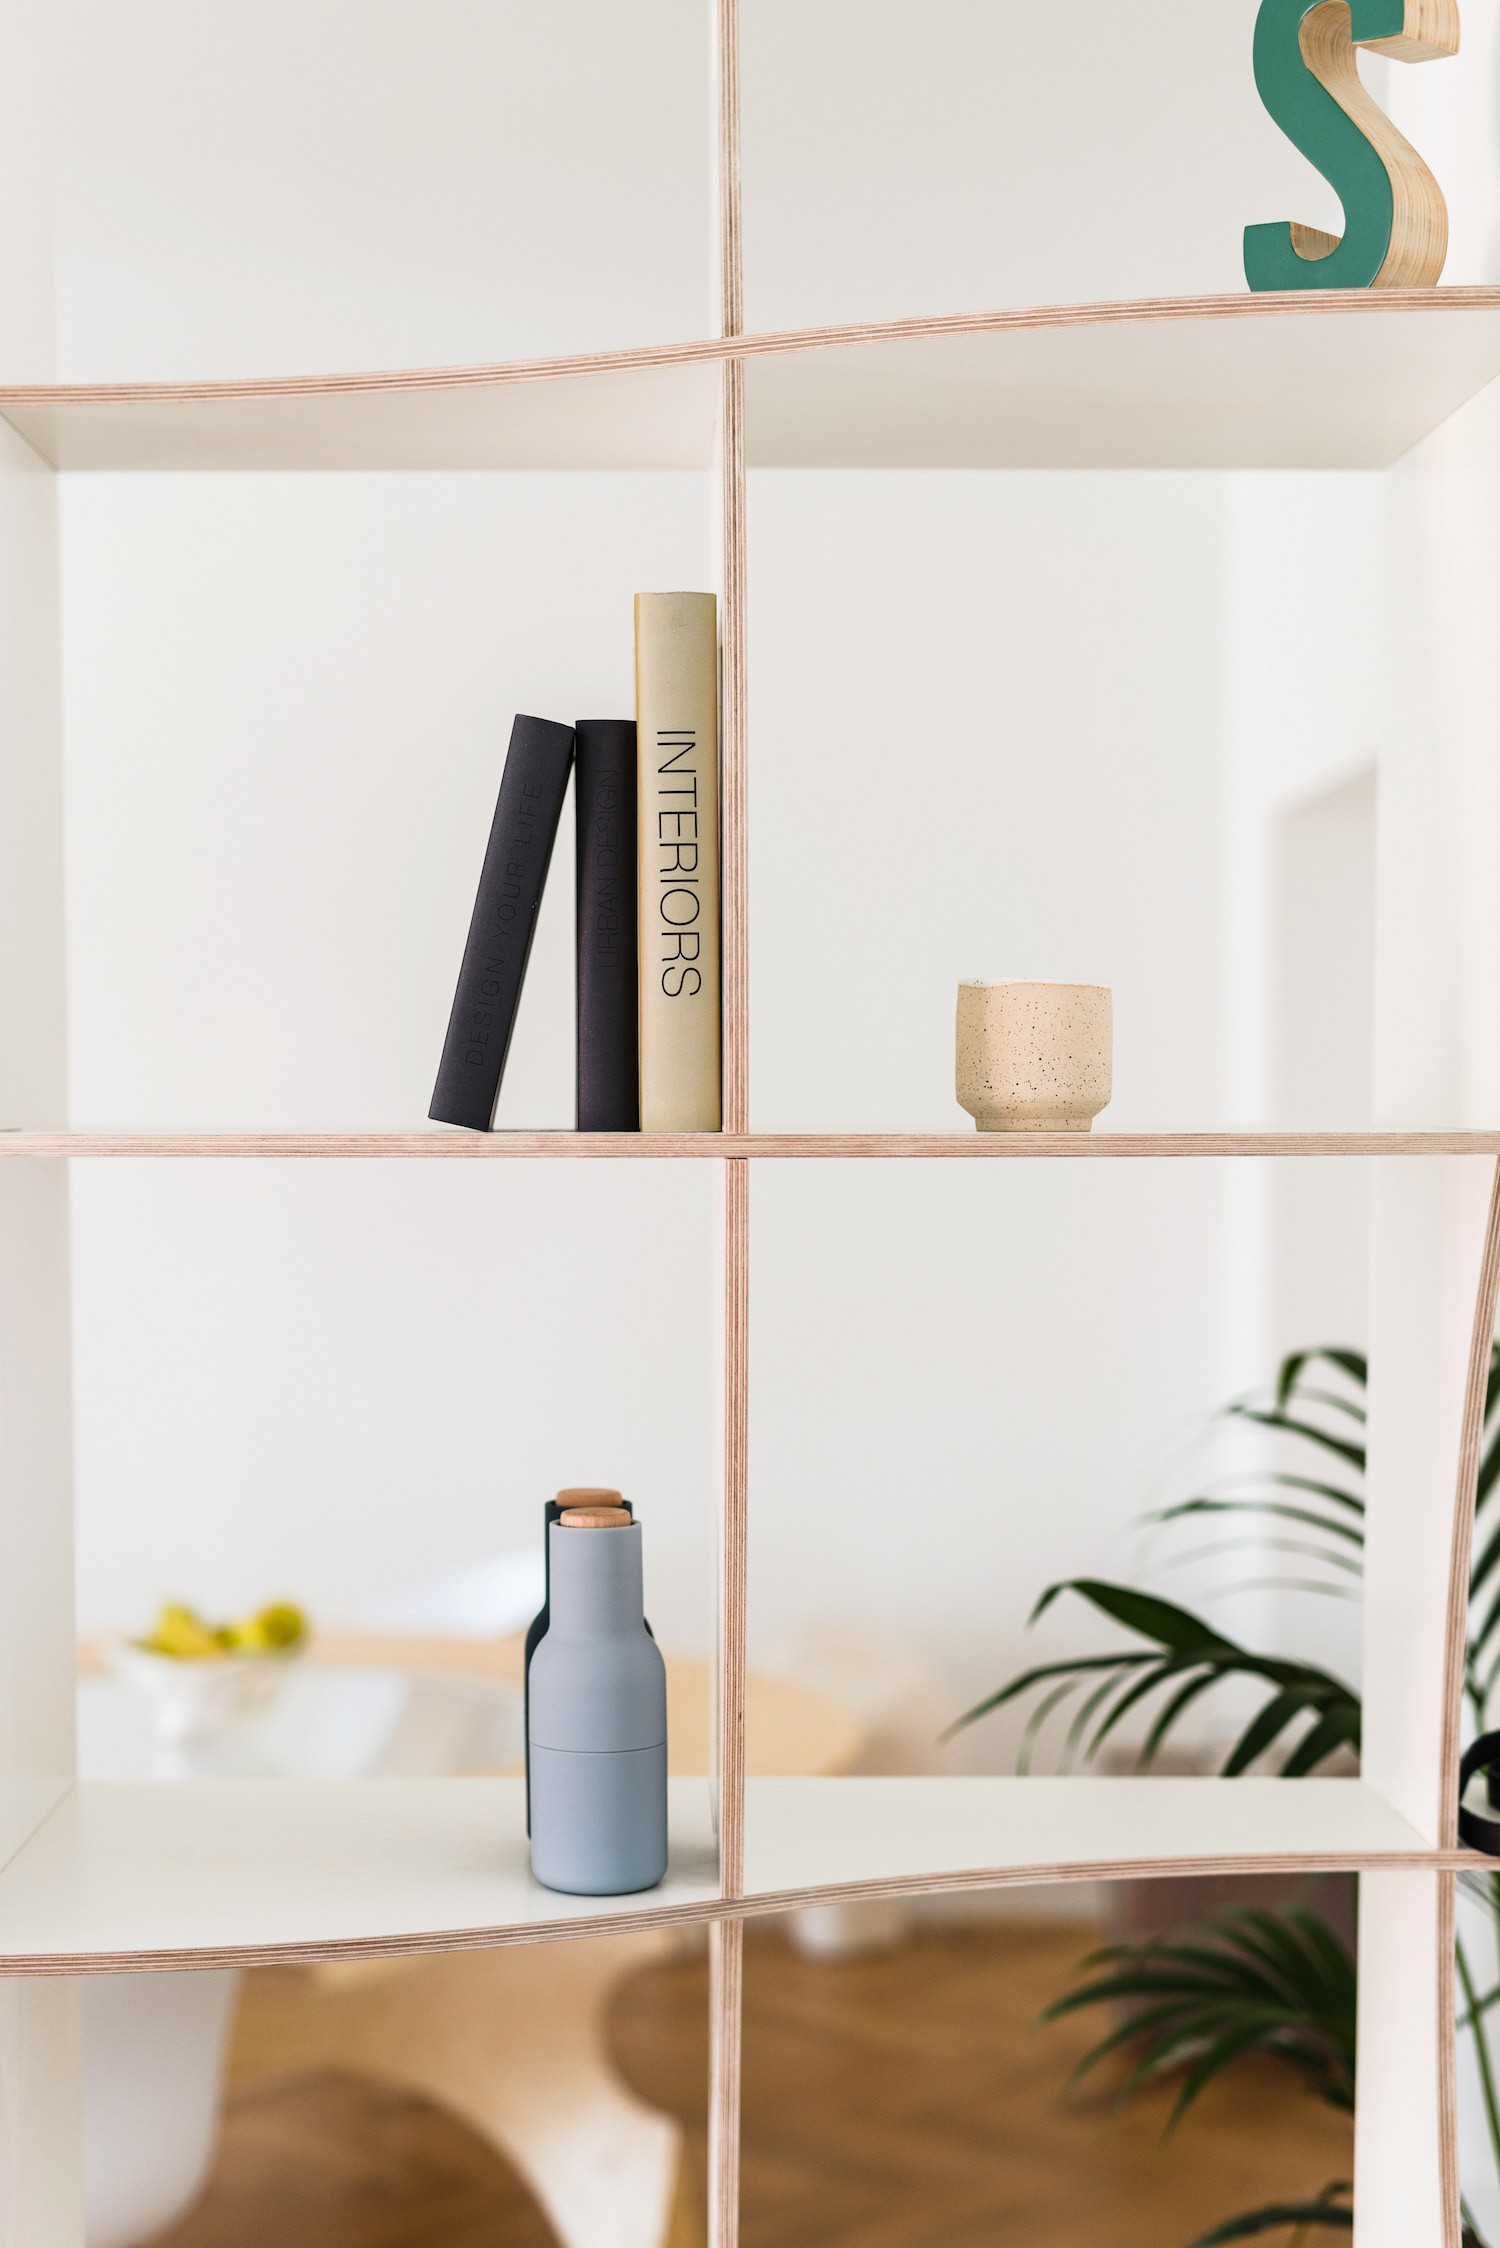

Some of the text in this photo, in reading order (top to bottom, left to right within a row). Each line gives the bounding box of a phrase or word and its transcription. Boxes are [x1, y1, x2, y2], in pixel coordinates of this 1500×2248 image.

[1243, 0, 1405, 292] S
[464, 783, 543, 1067] DESIGN YOUR LIFE
[597, 769, 621, 969] URBAN DESIGN
[657, 731, 702, 998] INTERIORS
